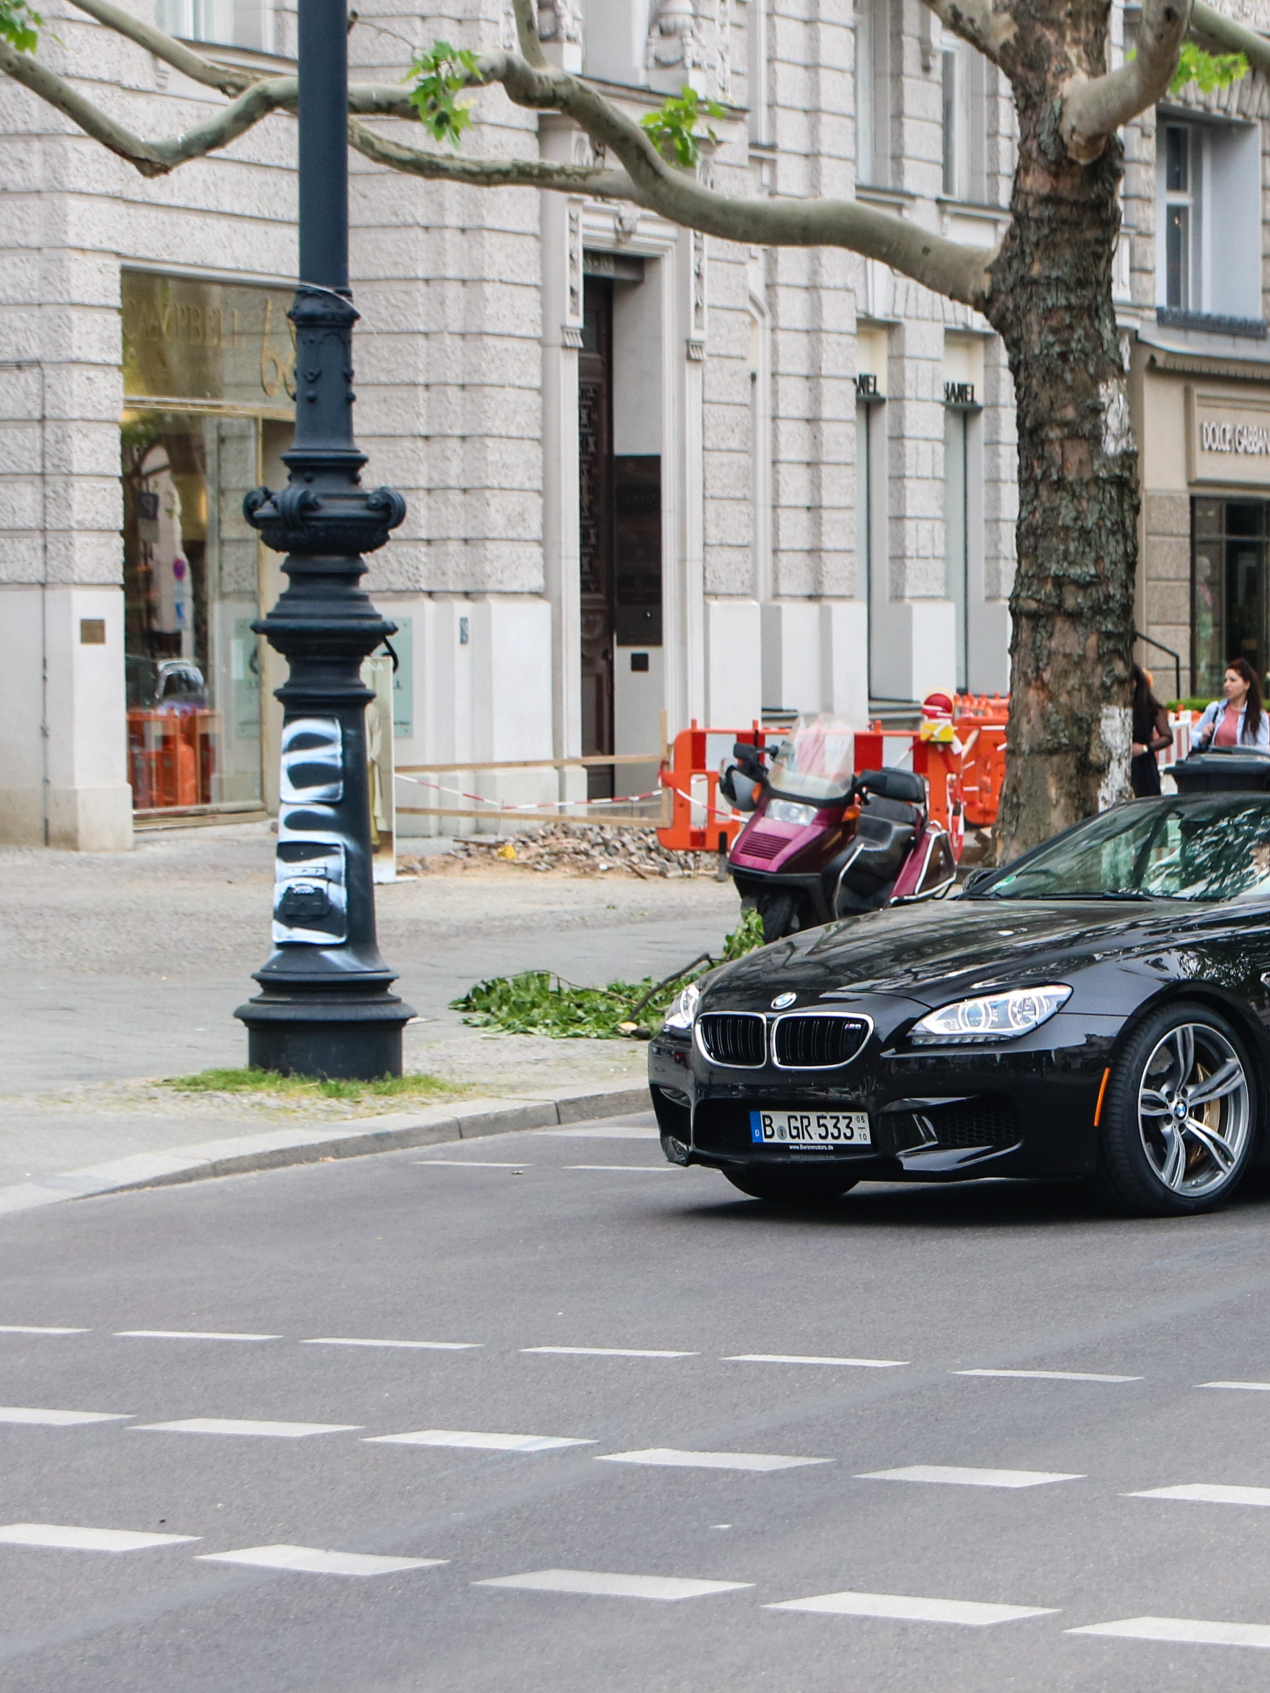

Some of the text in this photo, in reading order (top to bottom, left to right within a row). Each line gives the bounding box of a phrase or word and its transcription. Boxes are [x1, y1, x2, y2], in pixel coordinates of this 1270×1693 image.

[762, 1114, 775, 1139] B
[787, 1115, 813, 1140] GR
[816, 1115, 854, 1140] 533
